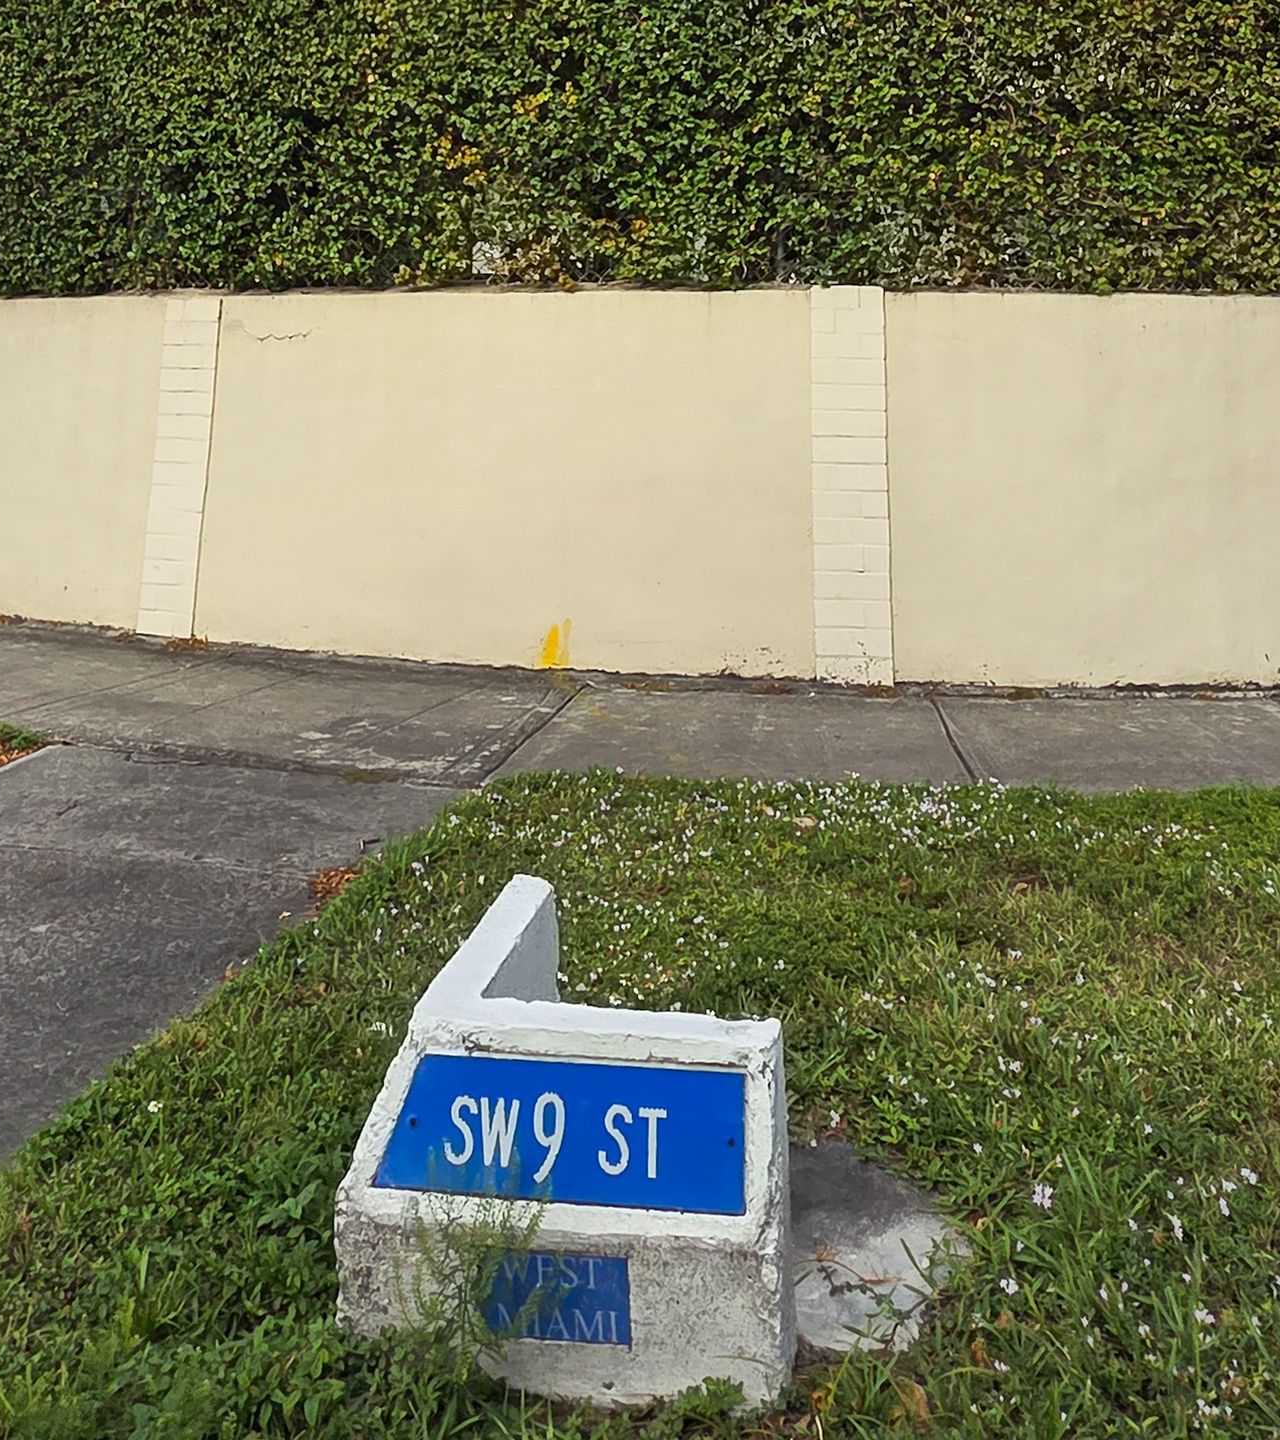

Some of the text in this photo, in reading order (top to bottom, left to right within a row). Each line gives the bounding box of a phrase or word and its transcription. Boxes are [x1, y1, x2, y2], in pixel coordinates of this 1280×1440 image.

[597, 1103, 668, 1180] ST
[503, 1254, 603, 1290] WEST
[497, 1302, 619, 1343] MIAMI
